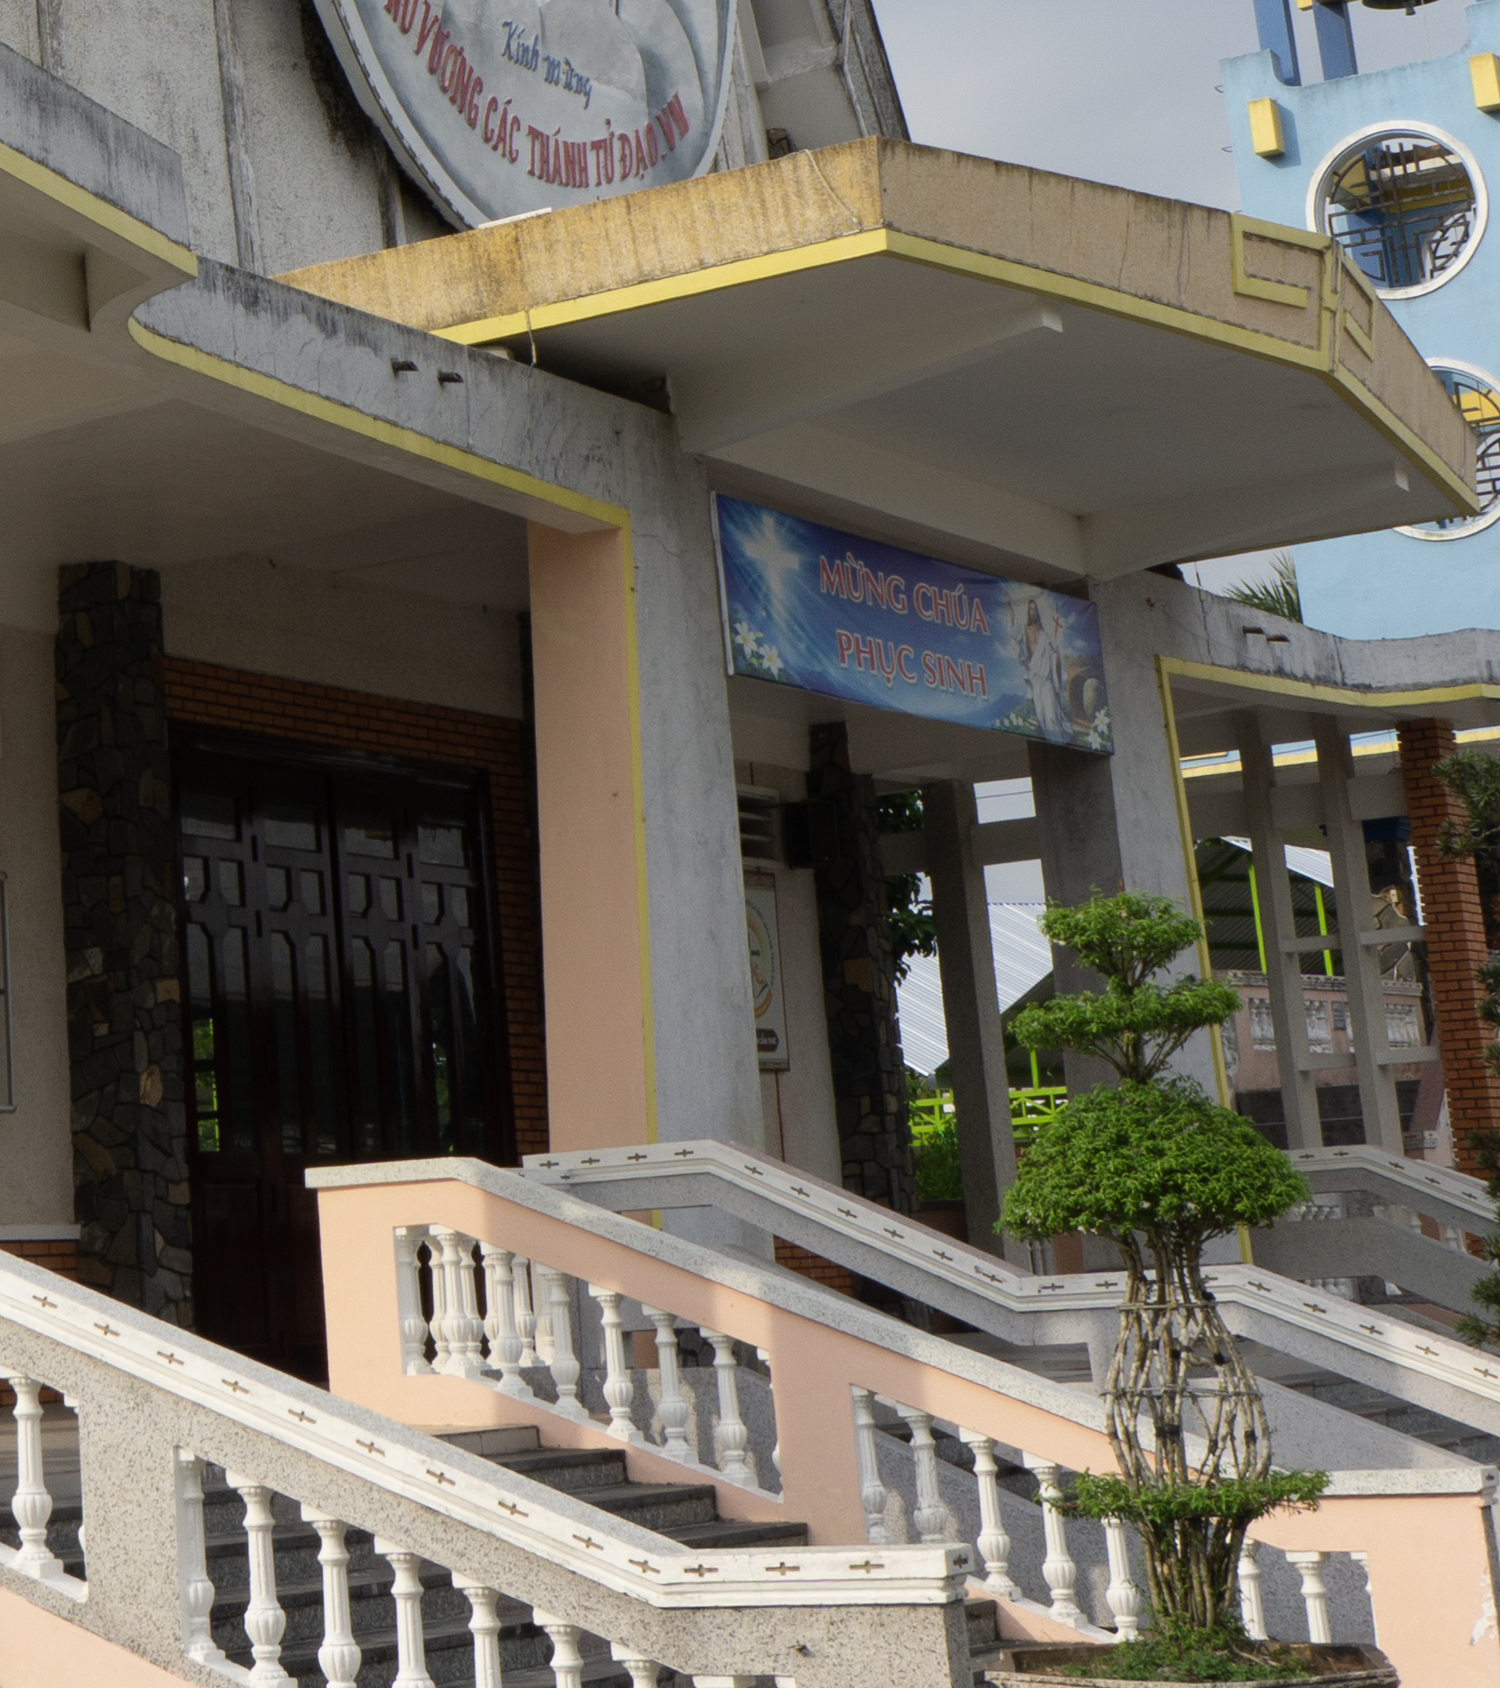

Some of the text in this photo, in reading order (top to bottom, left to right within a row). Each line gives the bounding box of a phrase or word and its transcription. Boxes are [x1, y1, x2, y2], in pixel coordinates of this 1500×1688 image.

[501, 21, 539, 72] Kính
[483, 96, 521, 163] CÁC
[526, 124, 590, 188] THÁNH
[590, 118, 615, 187] TỬ
[820, 552, 990, 635] MỪNG CHÚA
[836, 629, 989, 699] PHỤC SINH
